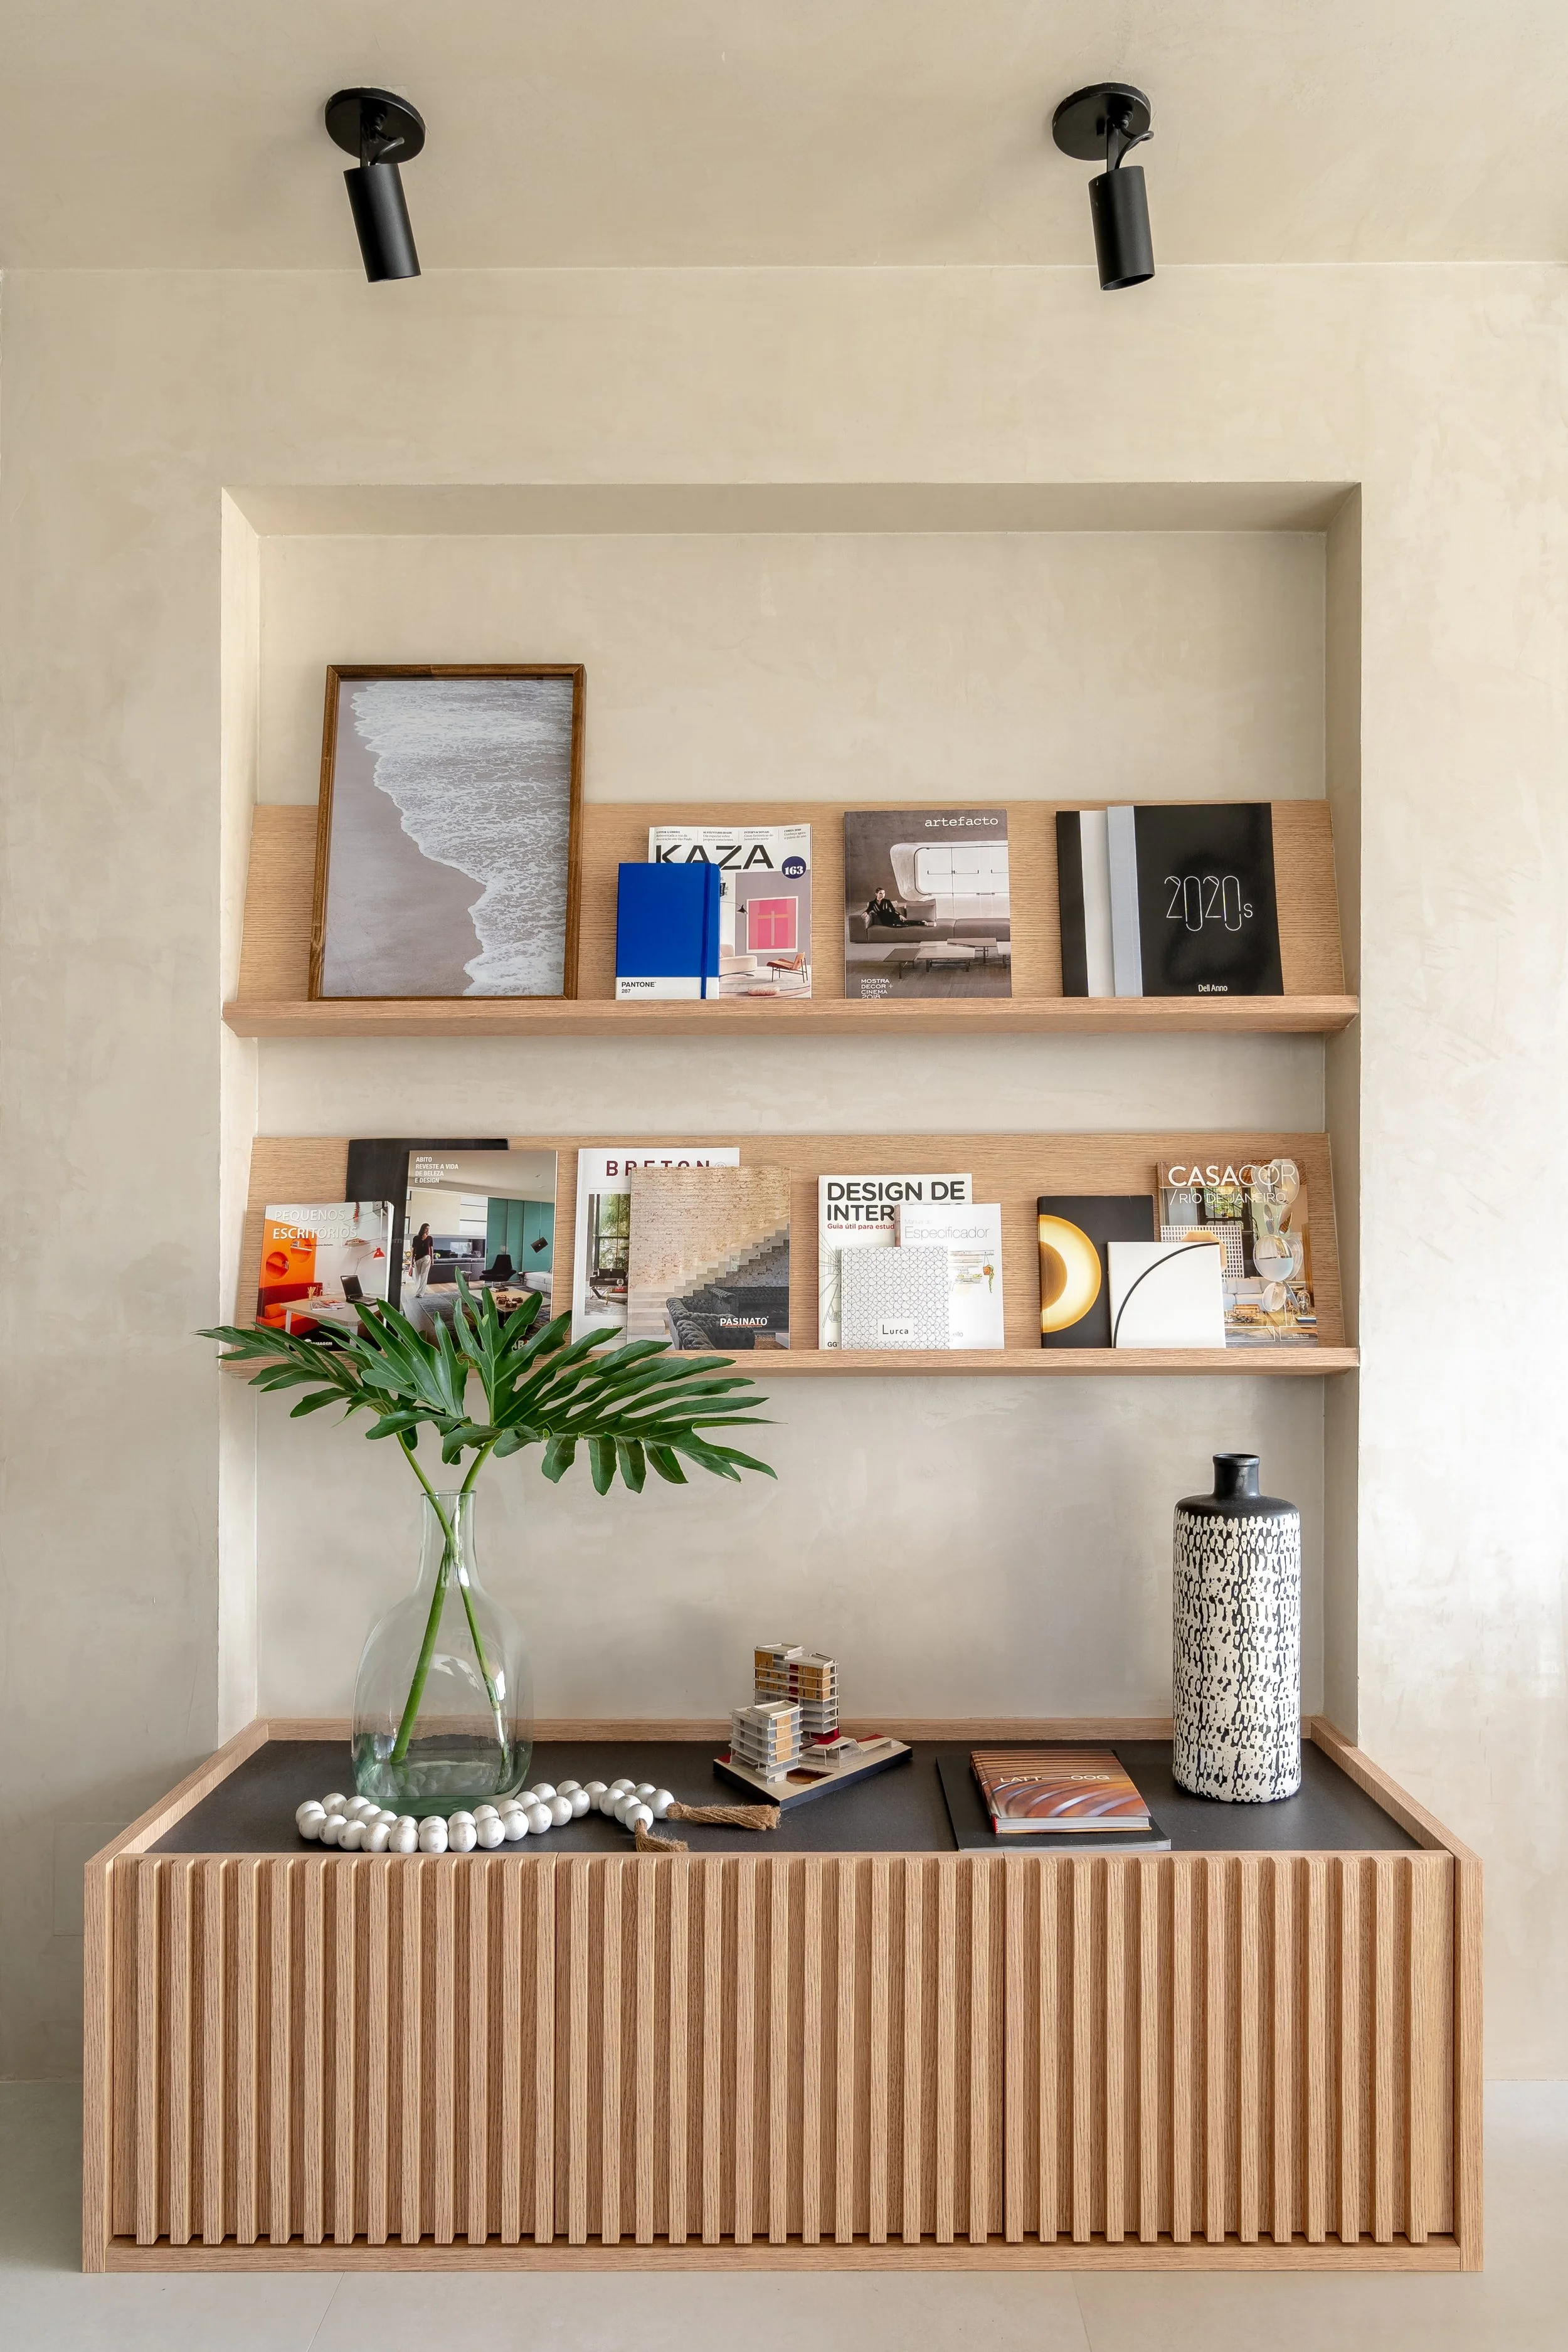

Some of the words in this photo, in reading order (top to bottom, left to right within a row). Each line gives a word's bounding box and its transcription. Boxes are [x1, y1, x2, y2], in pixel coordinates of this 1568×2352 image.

[924, 816, 999, 827] artefacto
[655, 844, 775, 871] KAZA
[784, 866, 804, 876] 163
[1198, 984, 1210, 992] Dell
[827, 1182, 923, 1201] DESIGN
[931, 1180, 965, 1200] DE
[1206, 1193, 1224, 1204] DE
[1230, 1192, 1286, 1204] JANEIRO
[275, 1209, 346, 1222] PEQUENOS
[827, 1204, 896, 1222] INTER
[273, 1225, 359, 1240] ESCRITÓRIOS
[904, 1226, 990, 1241] Especificador
[719, 1317, 768, 1327] PASINATO
[882, 1324, 909, 1335] Lurca
